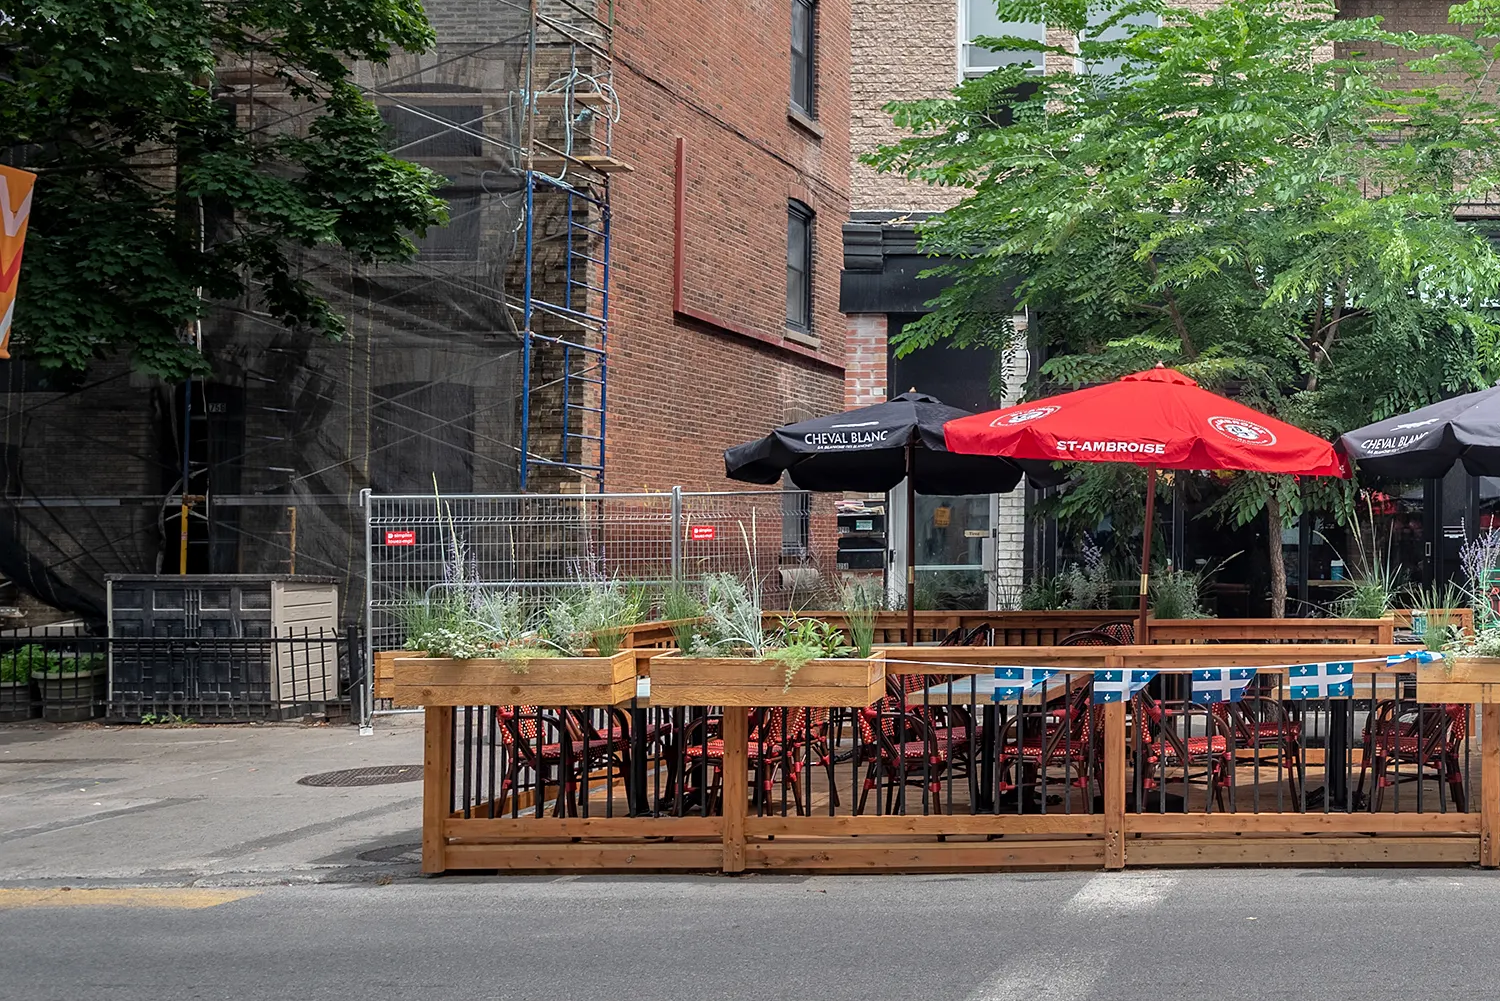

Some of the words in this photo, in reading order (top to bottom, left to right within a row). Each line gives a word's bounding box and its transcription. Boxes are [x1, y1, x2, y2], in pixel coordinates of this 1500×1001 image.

[804, 432, 849, 445] CHEVAL
[851, 430, 888, 444] BLANC
[1361, 437, 1397, 450] CHEVAL
[1056, 440, 1165, 454] ST-AMBROISE
